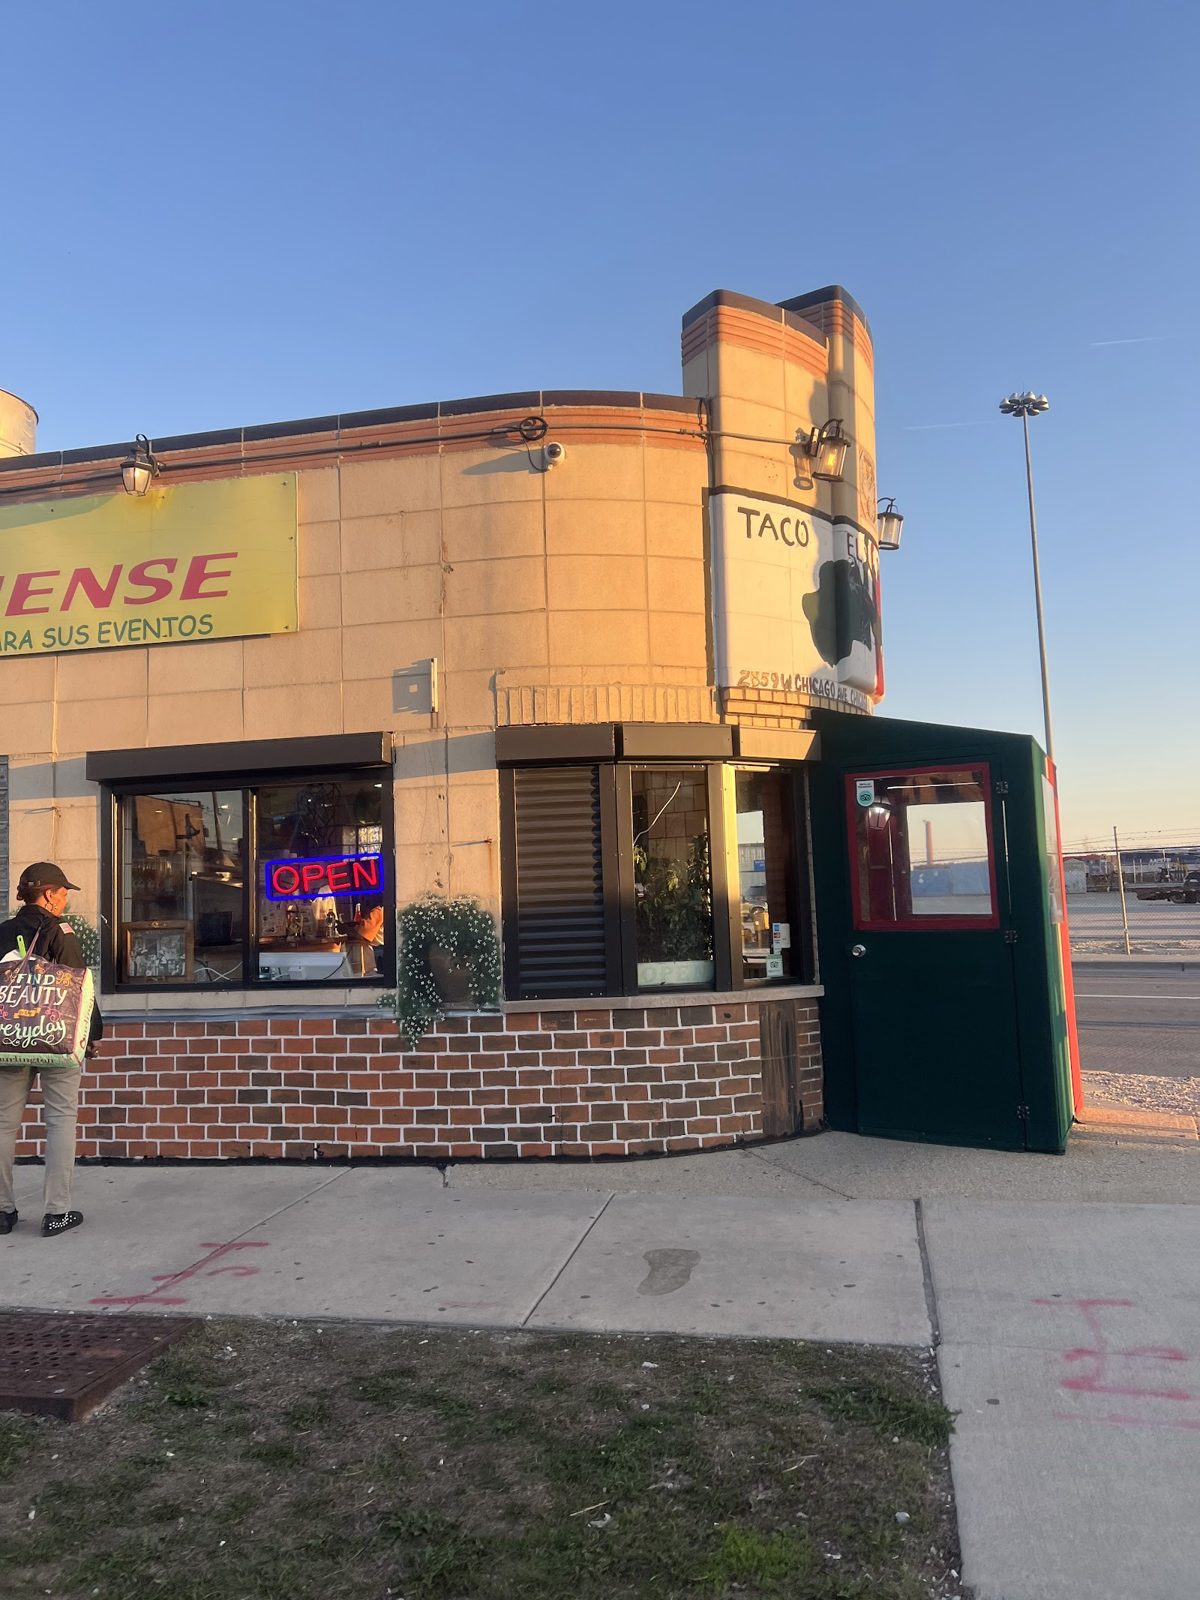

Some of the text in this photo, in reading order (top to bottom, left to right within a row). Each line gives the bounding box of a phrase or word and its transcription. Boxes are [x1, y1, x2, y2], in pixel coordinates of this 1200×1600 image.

[737, 506, 810, 548] TACO
[0, 551, 239, 617] ENSE
[0, 613, 214, 652] RA SUS EVENTOS
[738, 669, 779, 689] 2859
[781, 673, 793, 692] W
[794, 673, 835, 698] CHICAGO
[272, 859, 378, 894] OPEN
[16, 973, 56, 986] FIND
[0, 985, 68, 1008] BEAUTY
[0, 1054, 54, 1065] urlington
